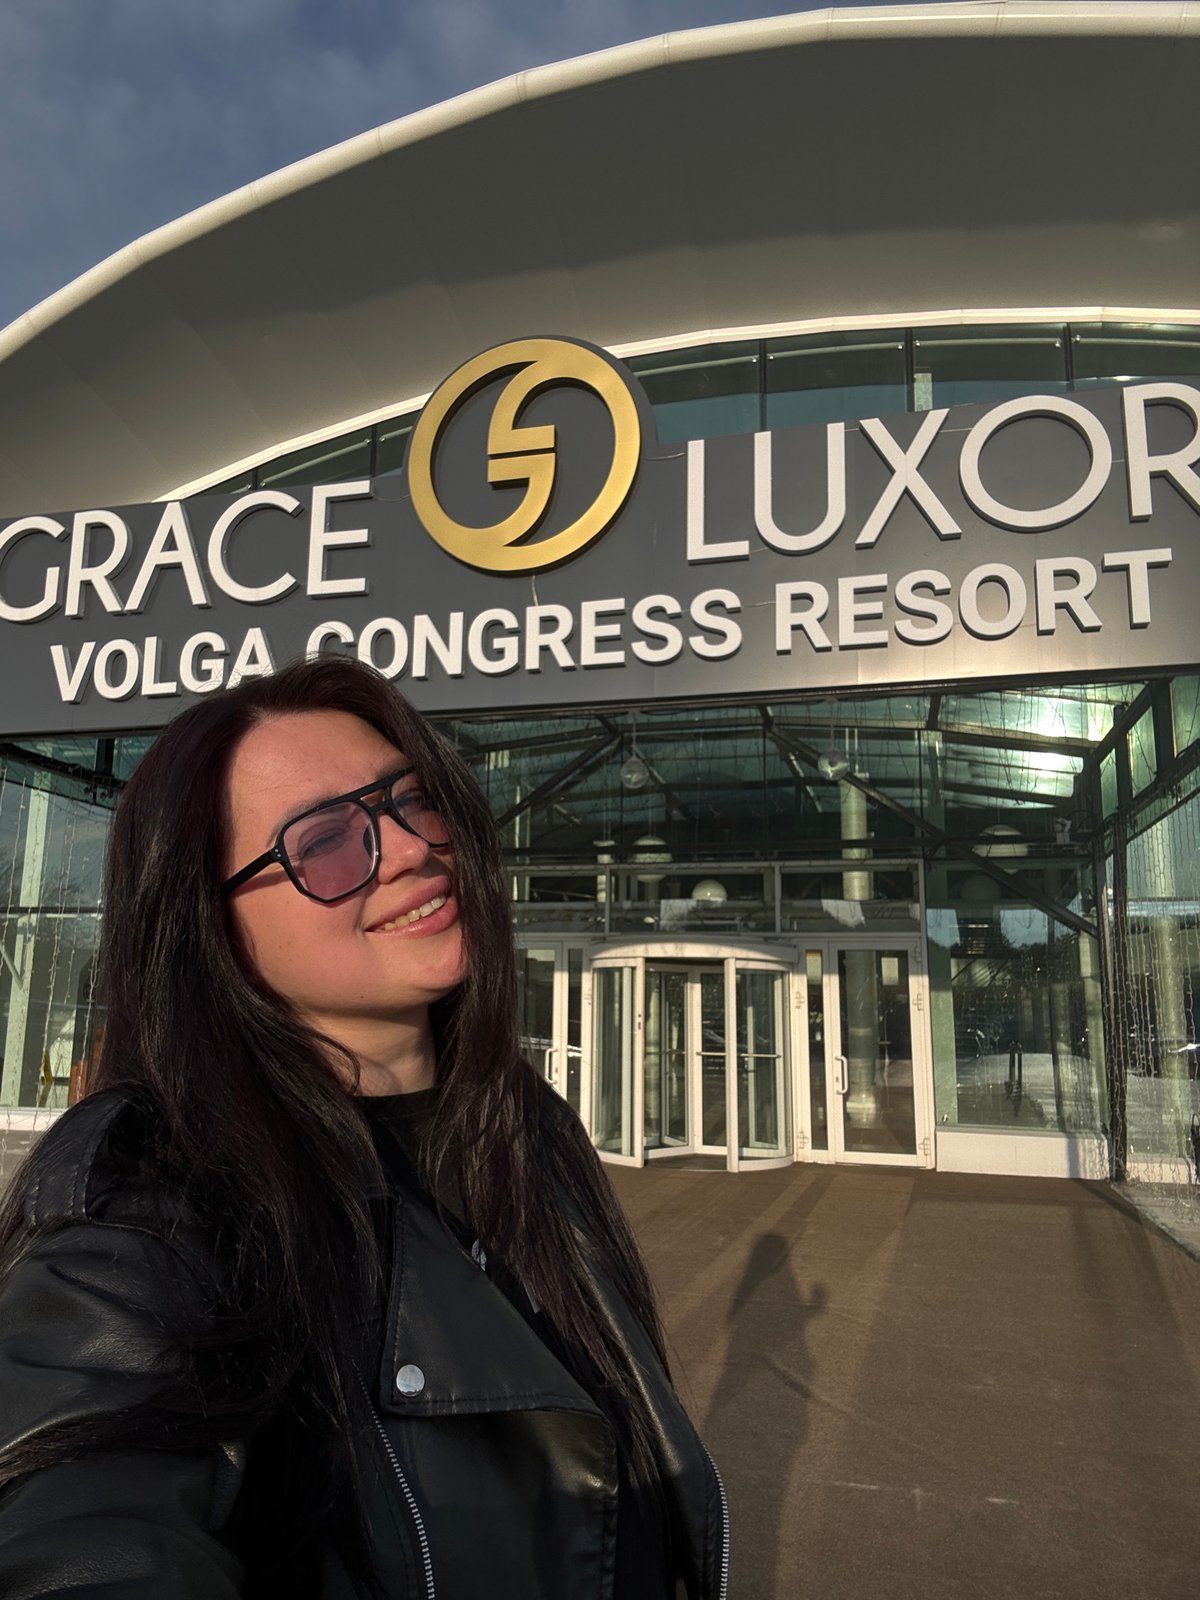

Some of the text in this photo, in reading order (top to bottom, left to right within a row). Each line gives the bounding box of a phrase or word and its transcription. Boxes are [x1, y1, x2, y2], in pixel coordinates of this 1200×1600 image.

[0, 382, 1200, 623] GRACE LUXOR
[50, 548, 1173, 703] VOLGA CONGRESS RESORT
